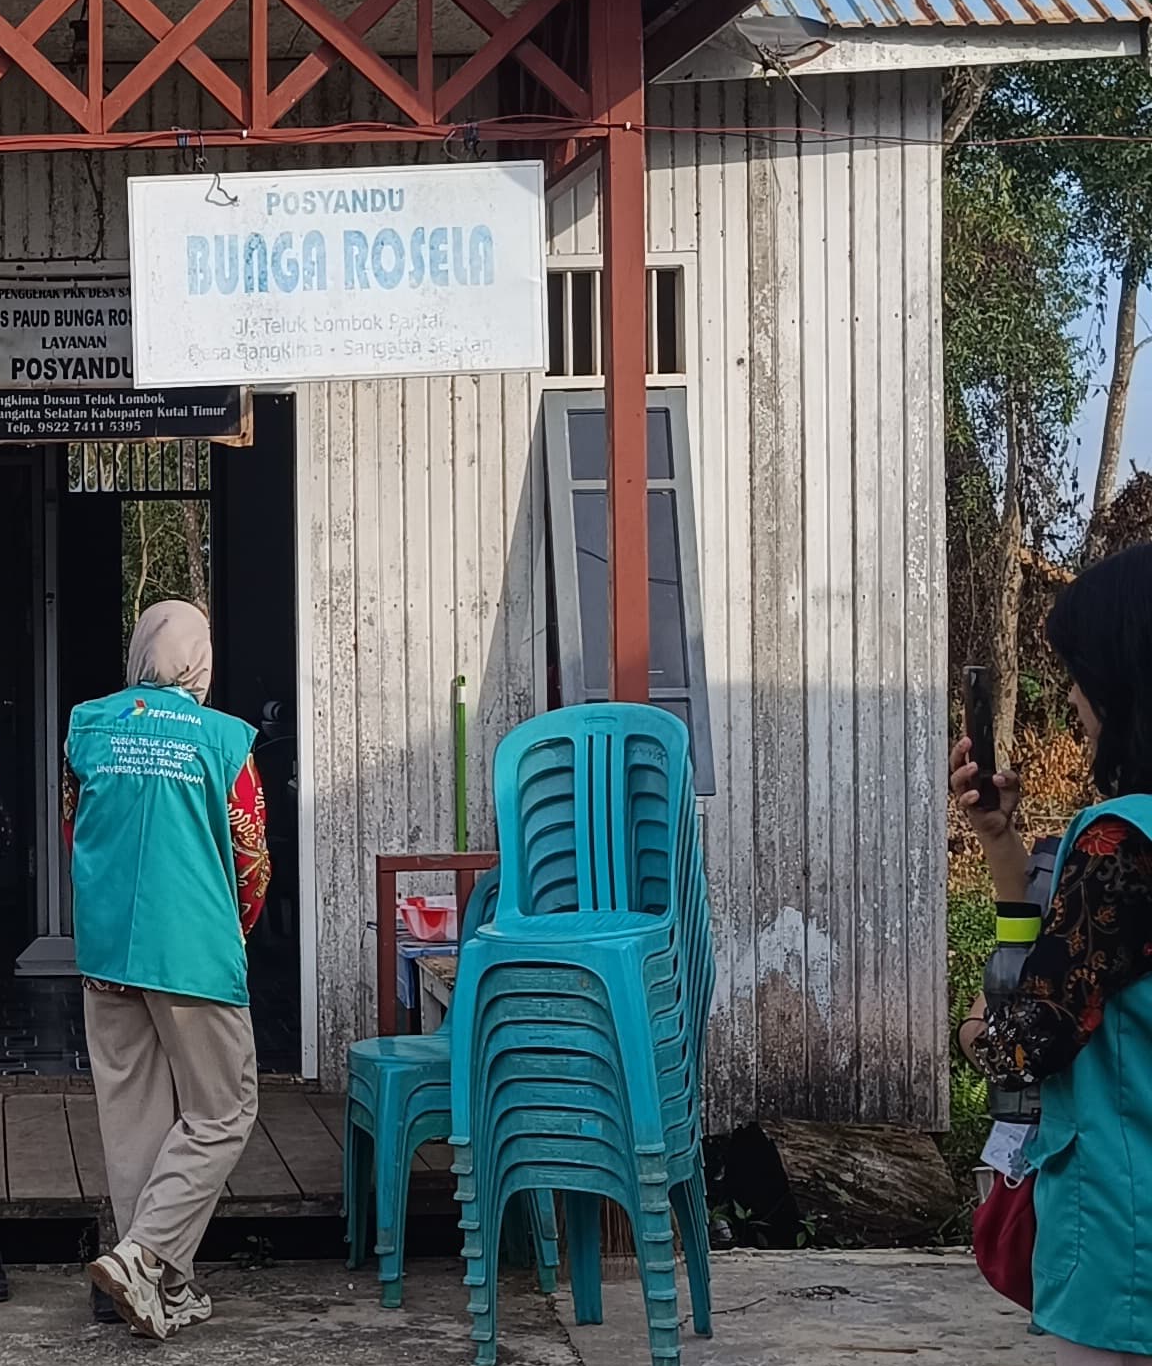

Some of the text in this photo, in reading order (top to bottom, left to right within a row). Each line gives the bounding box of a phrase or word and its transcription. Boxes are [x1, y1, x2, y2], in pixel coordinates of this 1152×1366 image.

[266, 187, 405, 216] POSYANDU
[186, 224, 495, 295] BUNGA ROSELA
[63, 288, 86, 300] PKK
[87, 287, 115, 299] DESA
[13, 309, 50, 327] PAUD
[54, 309, 104, 326] BUNGA
[260, 315, 307, 335] Teluk
[314, 314, 383, 333] Lombok
[41, 336, 107, 349] LAYANAN
[11, 357, 133, 380] POSYANDU
[43, 394, 80, 405] Dusun
[83, 394, 116, 405] Teluk
[119, 393, 165, 405] Lombok
[44, 408, 87, 419] Selatan
[91, 407, 153, 420] Kabupaten
[157, 406, 188, 418] Kutai
[191, 405, 227, 417] Timur
[6, 421, 34, 435] Telp.
[73, 421, 104, 432] 7411
[110, 420, 141, 432] 5395
[148, 708, 202, 726] PERTAMINA
[110, 736, 198, 753] DUSUN TELUK LOMBOK
[118, 755, 183, 769] FAKULTAS TEKNIK
[129, 747, 148, 755] BINA
[150, 748, 171, 757] DESA
[173, 751, 194, 762] 2025
[96, 764, 205, 784] UNIVERSITAS MULAWARMAN
